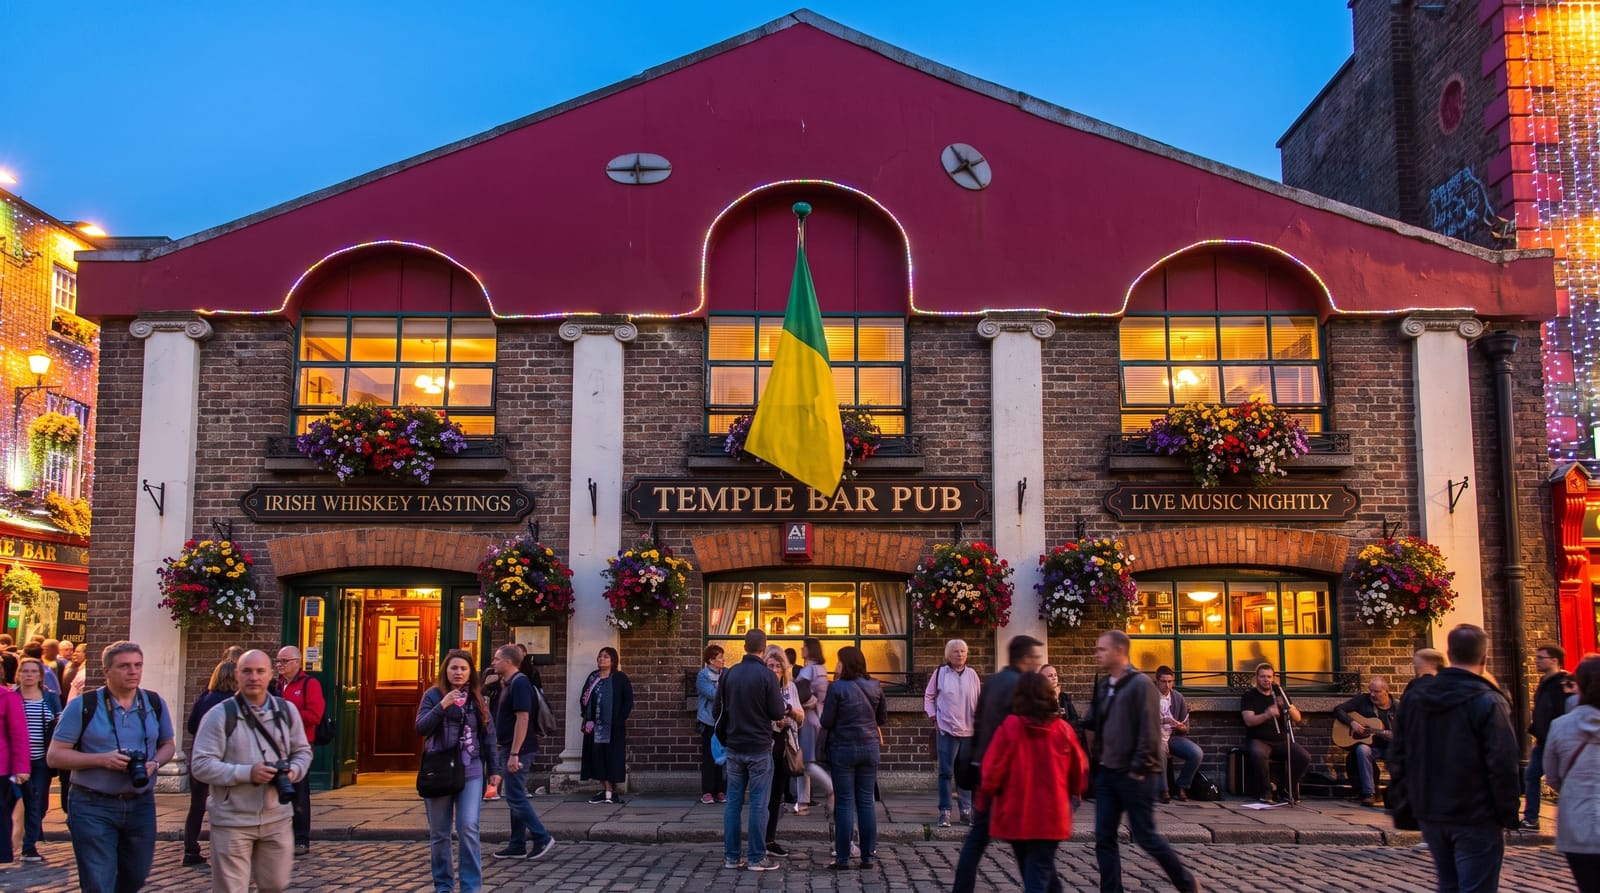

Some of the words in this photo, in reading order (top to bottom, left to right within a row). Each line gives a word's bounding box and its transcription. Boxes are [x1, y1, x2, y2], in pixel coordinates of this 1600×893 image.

[265, 494, 316, 511] IRISH
[322, 494, 413, 511] WHISKEY
[418, 494, 511, 512] TASTINGS
[653, 486, 795, 512] TEMPLE
[806, 486, 879, 512] BAR
[890, 486, 962, 512] PUB
[1131, 494, 1176, 510] LIVE
[1180, 494, 1243, 510] MUSIC
[1247, 494, 1333, 510] NIGHTLY
[0, 539, 15, 557] E
[22, 542, 56, 561] BAR
